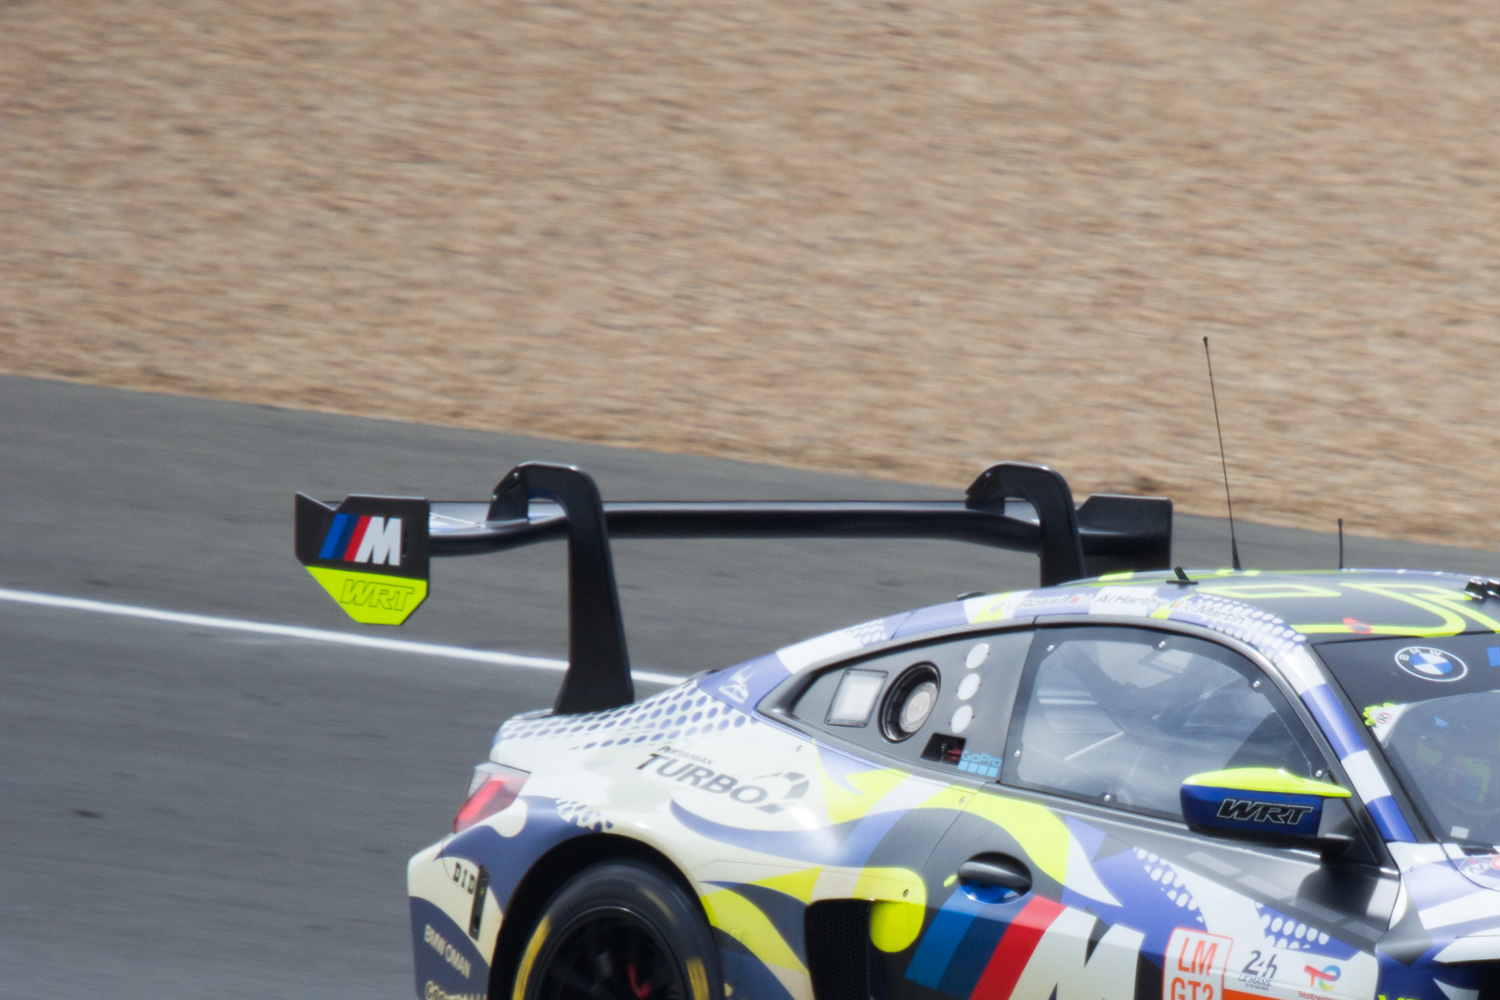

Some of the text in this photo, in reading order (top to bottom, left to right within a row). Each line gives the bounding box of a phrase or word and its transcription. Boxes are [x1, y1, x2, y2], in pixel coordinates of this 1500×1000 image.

[340, 578, 415, 612] WRT
[960, 749, 1003, 769] GoPro
[635, 752, 769, 805] TURBO
[1216, 798, 1314, 826] WRT
[453, 861, 476, 895] DID
[1177, 937, 1219, 977] LM
[1241, 949, 1279, 980] 24h
